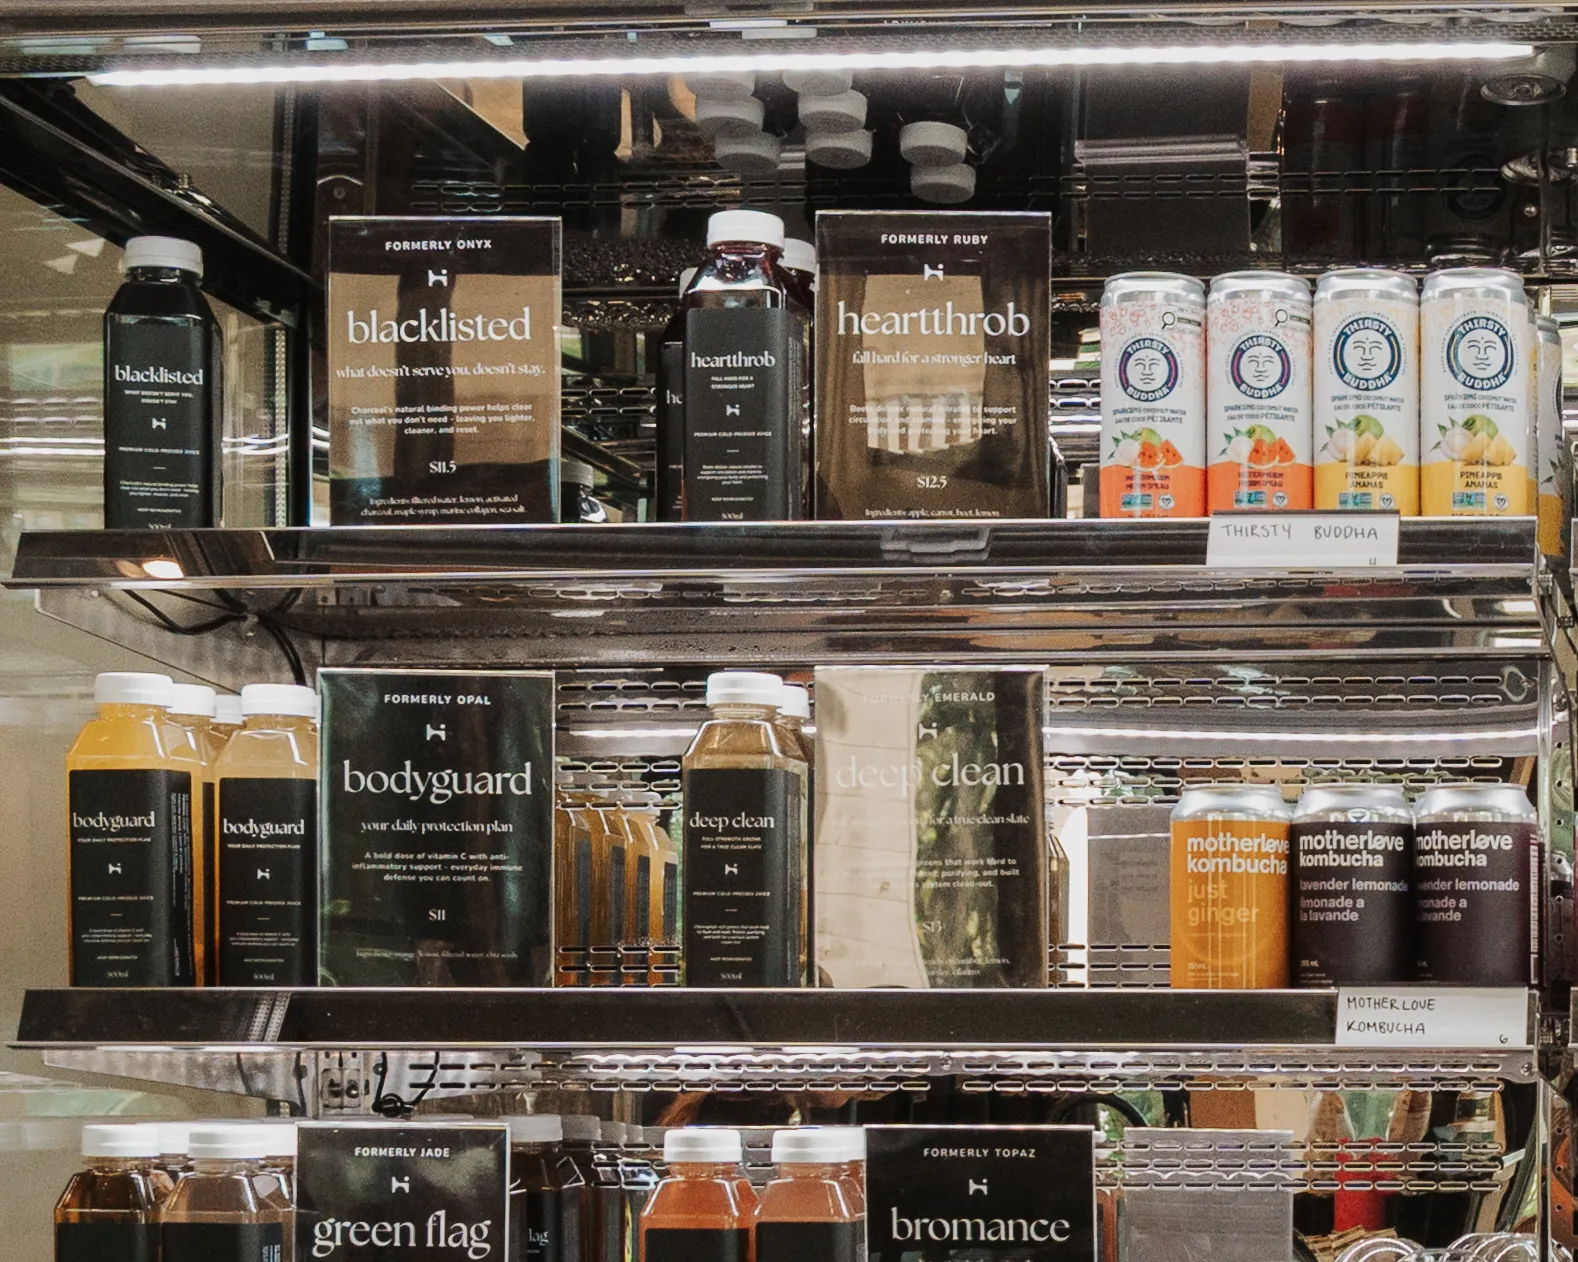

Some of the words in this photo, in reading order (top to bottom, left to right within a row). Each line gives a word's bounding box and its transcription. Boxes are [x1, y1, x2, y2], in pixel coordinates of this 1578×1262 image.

[385, 239, 452, 251] FORMERLY
[457, 239, 492, 250] ONYX
[881, 234, 949, 245] FORMERLY
[953, 234, 988, 245] RUBY
[346, 305, 532, 345] blacklisted
[837, 300, 1031, 338] heartthrob
[1344, 315, 1392, 338] THIRSTY
[691, 351, 776, 369] heartthrob
[114, 364, 204, 385] blacklisted
[1341, 372, 1395, 391] BUDDHA
[1221, 524, 1292, 540] THIRSTY
[1314, 525, 1378, 540] BUDDHA
[384, 694, 451, 704] FORMERLY
[457, 694, 491, 704] OPAL
[935, 691, 995, 702] EMERALD
[343, 760, 533, 804] bodyguard
[836, 755, 922, 796] deep
[931, 753, 1025, 787] clean
[223, 817, 304, 839] bodyguard
[360, 821, 388, 834] your
[390, 818, 420, 834] daily
[421, 819, 485, 835] protection
[486, 821, 514, 834] plan
[689, 813, 728, 833] deep
[732, 812, 775, 829] clean
[1187, 853, 1288, 875] kombucha
[1300, 850, 1384, 867] kombucha
[1188, 880, 1228, 903] just
[1188, 904, 1260, 926] ginger
[1347, 1020, 1425, 1034] KOMBUCHA
[1498, 1034, 1508, 1044] 6
[354, 1146, 416, 1158] FORMERLY
[420, 1147, 450, 1158] JADE
[923, 1148, 989, 1158] FORMERLY
[995, 1148, 1036, 1159] TOPAZ
[311, 1217, 416, 1258] green
[426, 1210, 492, 1259] flag
[891, 1207, 1070, 1242] bromance
